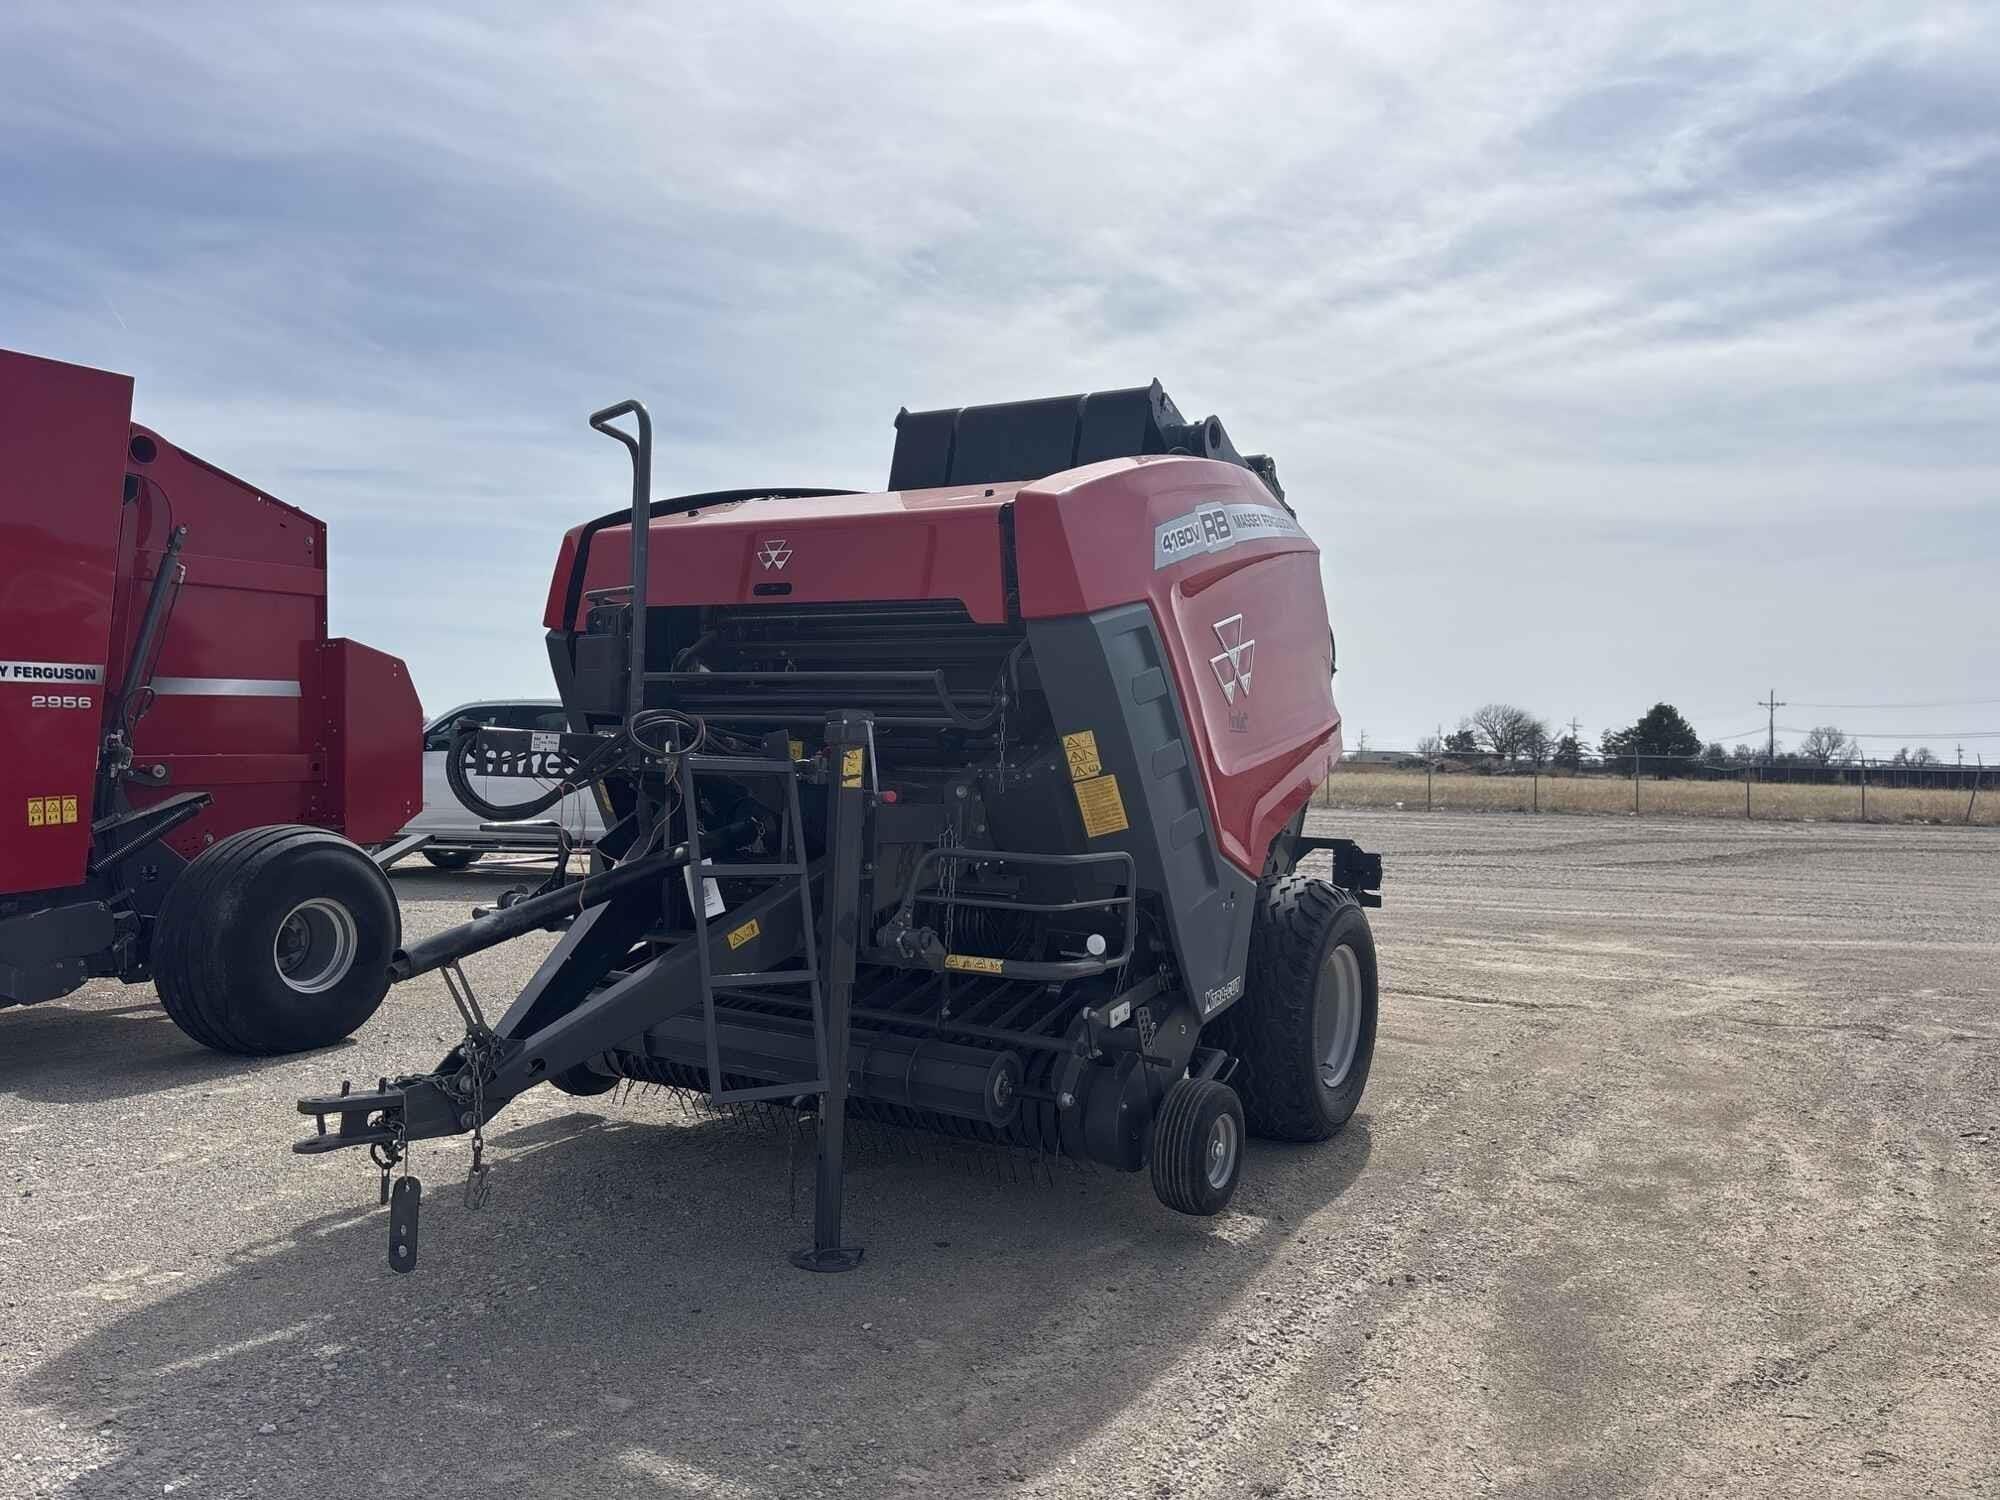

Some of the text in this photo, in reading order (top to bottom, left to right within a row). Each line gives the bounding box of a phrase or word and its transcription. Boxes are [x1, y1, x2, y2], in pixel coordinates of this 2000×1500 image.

[1162, 523, 1200, 552] 4180V
[1200, 510, 1232, 544] RB
[1232, 513, 1261, 529] MASSEY
[13, 666, 96, 680] FERGUSON
[31, 695, 92, 709] 2956
